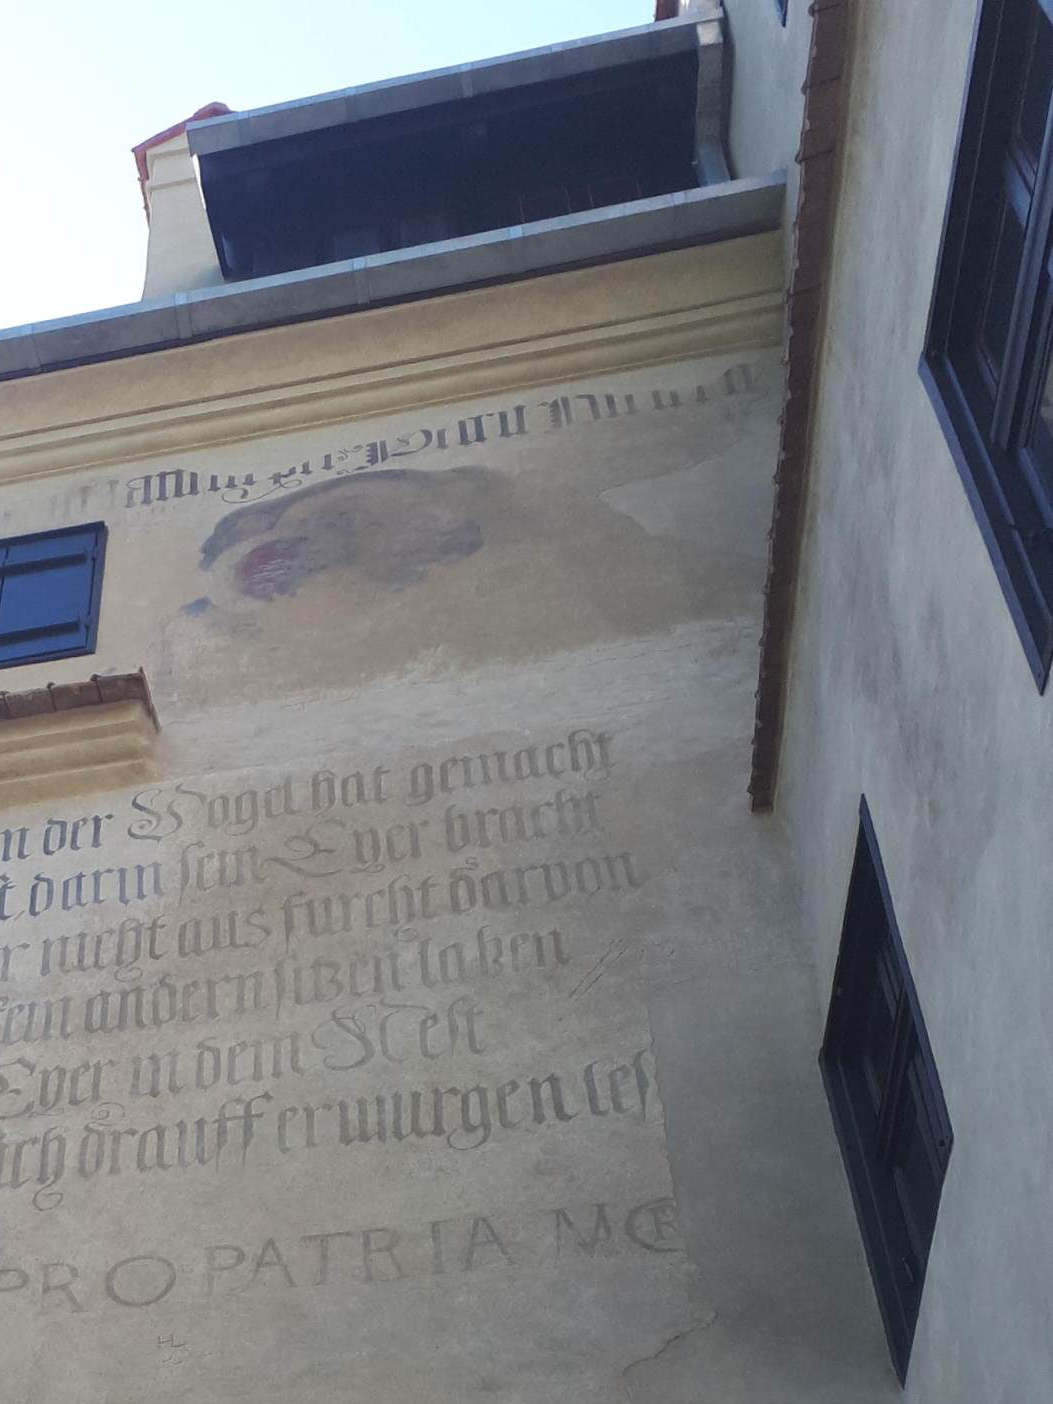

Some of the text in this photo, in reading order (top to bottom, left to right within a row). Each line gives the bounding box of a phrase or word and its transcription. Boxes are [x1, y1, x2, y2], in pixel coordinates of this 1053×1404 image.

[42, 810, 115, 858] der
[311, 766, 391, 818] hat
[406, 729, 615, 806] gemacht
[28, 860, 167, 923] darin
[445, 788, 604, 853] bracht
[39, 914, 167, 983] nicht
[178, 904, 272, 959] aus
[84, 969, 272, 1034] andern
[129, 1048, 186, 1098] in
[196, 1030, 315, 1090] dem
[203, 1213, 519, 1300] PATRIA
